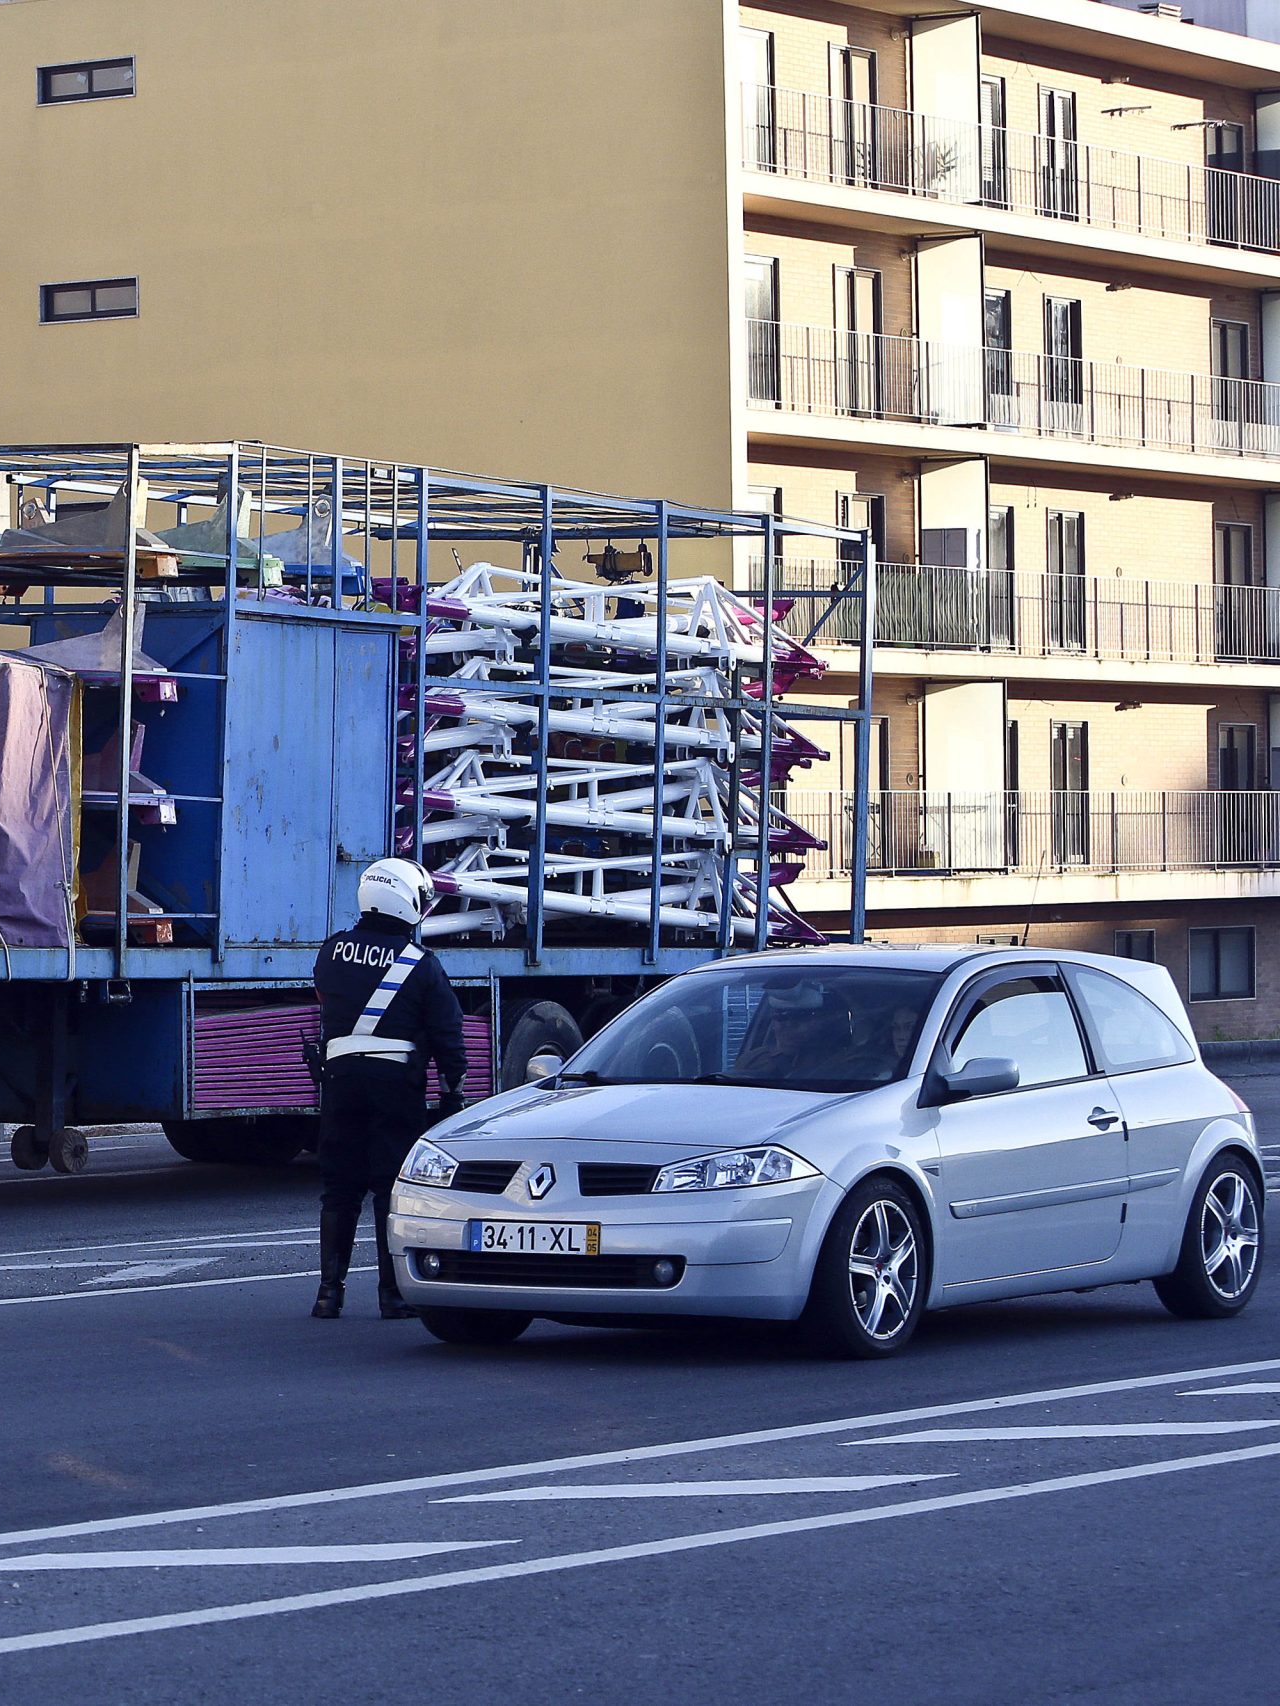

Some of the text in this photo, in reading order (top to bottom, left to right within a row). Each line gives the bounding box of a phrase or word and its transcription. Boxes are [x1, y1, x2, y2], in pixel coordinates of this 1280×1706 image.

[332, 941, 396, 968] POLICIA
[587, 1228, 597, 1237] 04
[473, 1239, 479, 1247] P
[586, 1243, 597, 1252] 05
